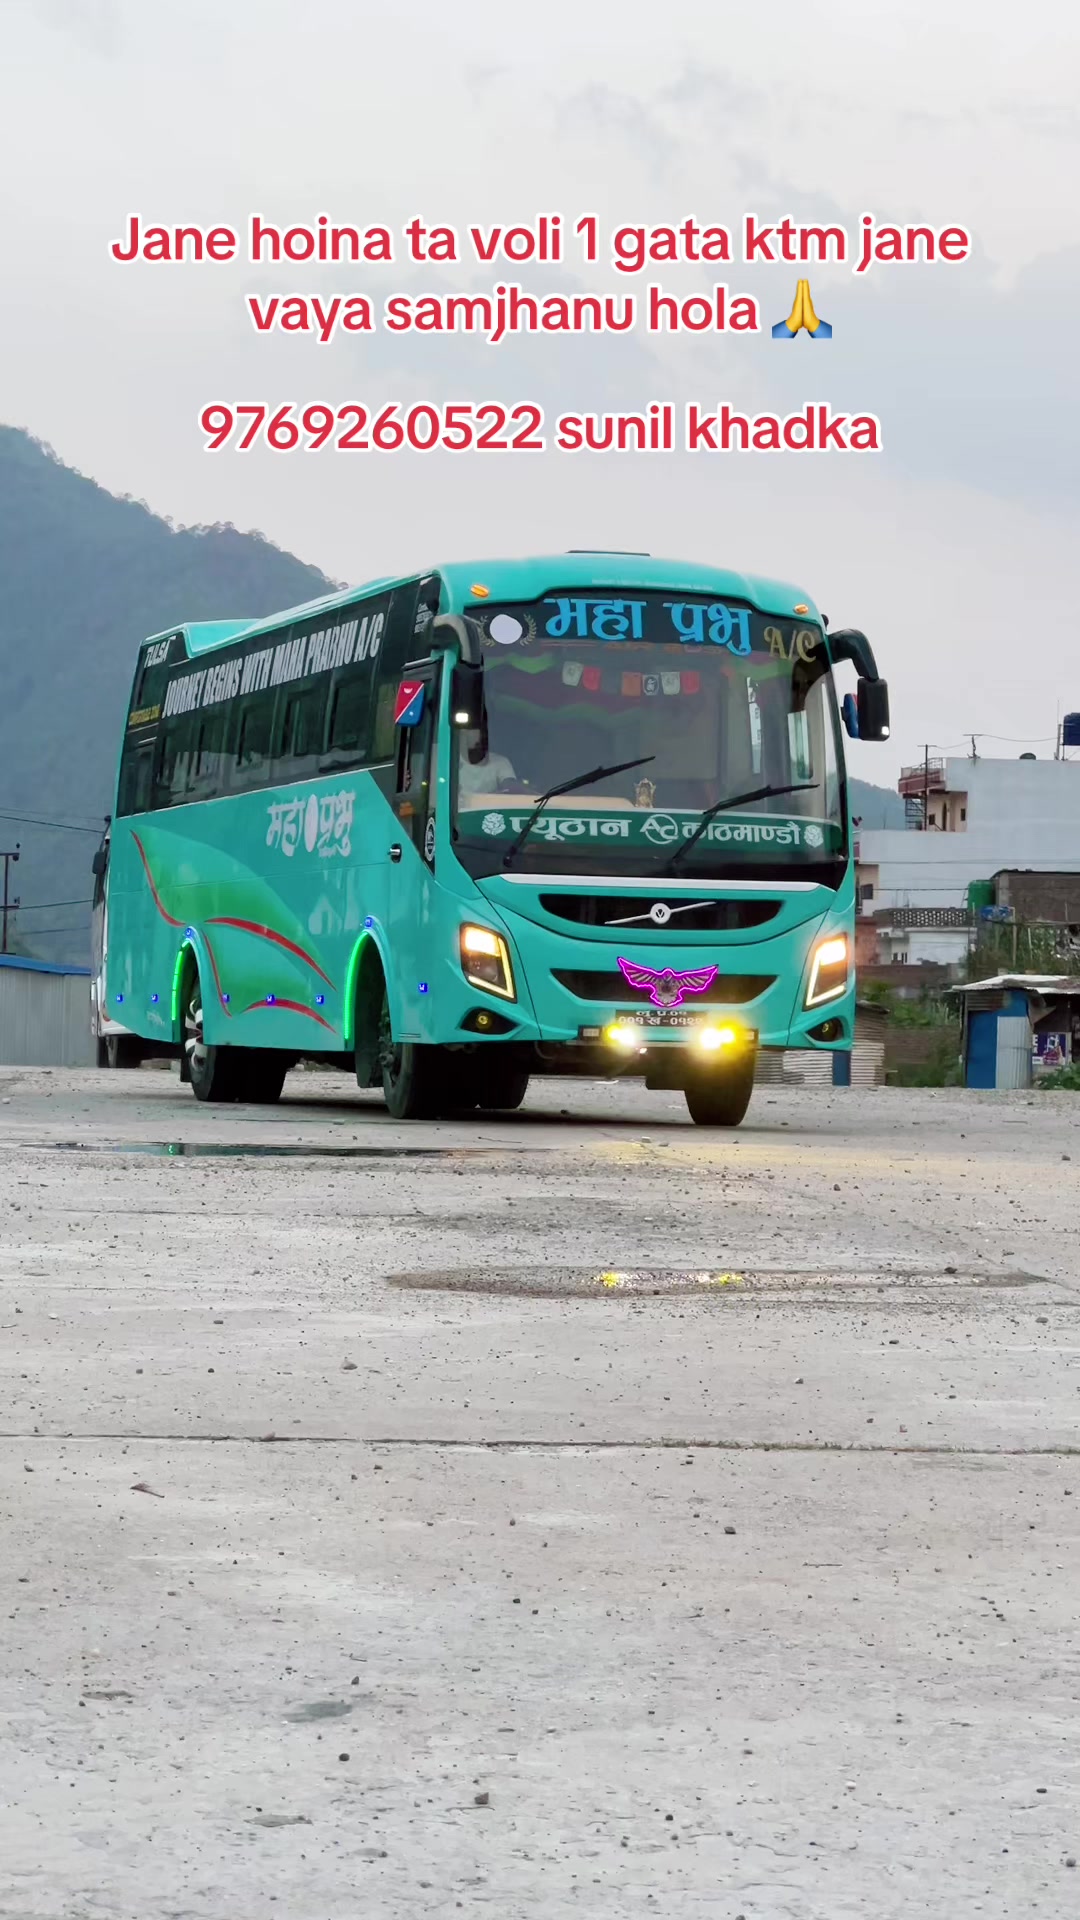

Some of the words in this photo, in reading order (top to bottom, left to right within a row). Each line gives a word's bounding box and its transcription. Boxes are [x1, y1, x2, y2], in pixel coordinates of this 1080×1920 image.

[162, 669, 208, 719] JOURNEY
[202, 658, 243, 707] BEGINS
[240, 647, 275, 696] WITH
[270, 636, 308, 687] MAHA
[304, 620, 359, 677] PRABHU
[353, 612, 385, 663] A/C
[543, 597, 647, 641] महा
[662, 602, 753, 657] प्रभु
